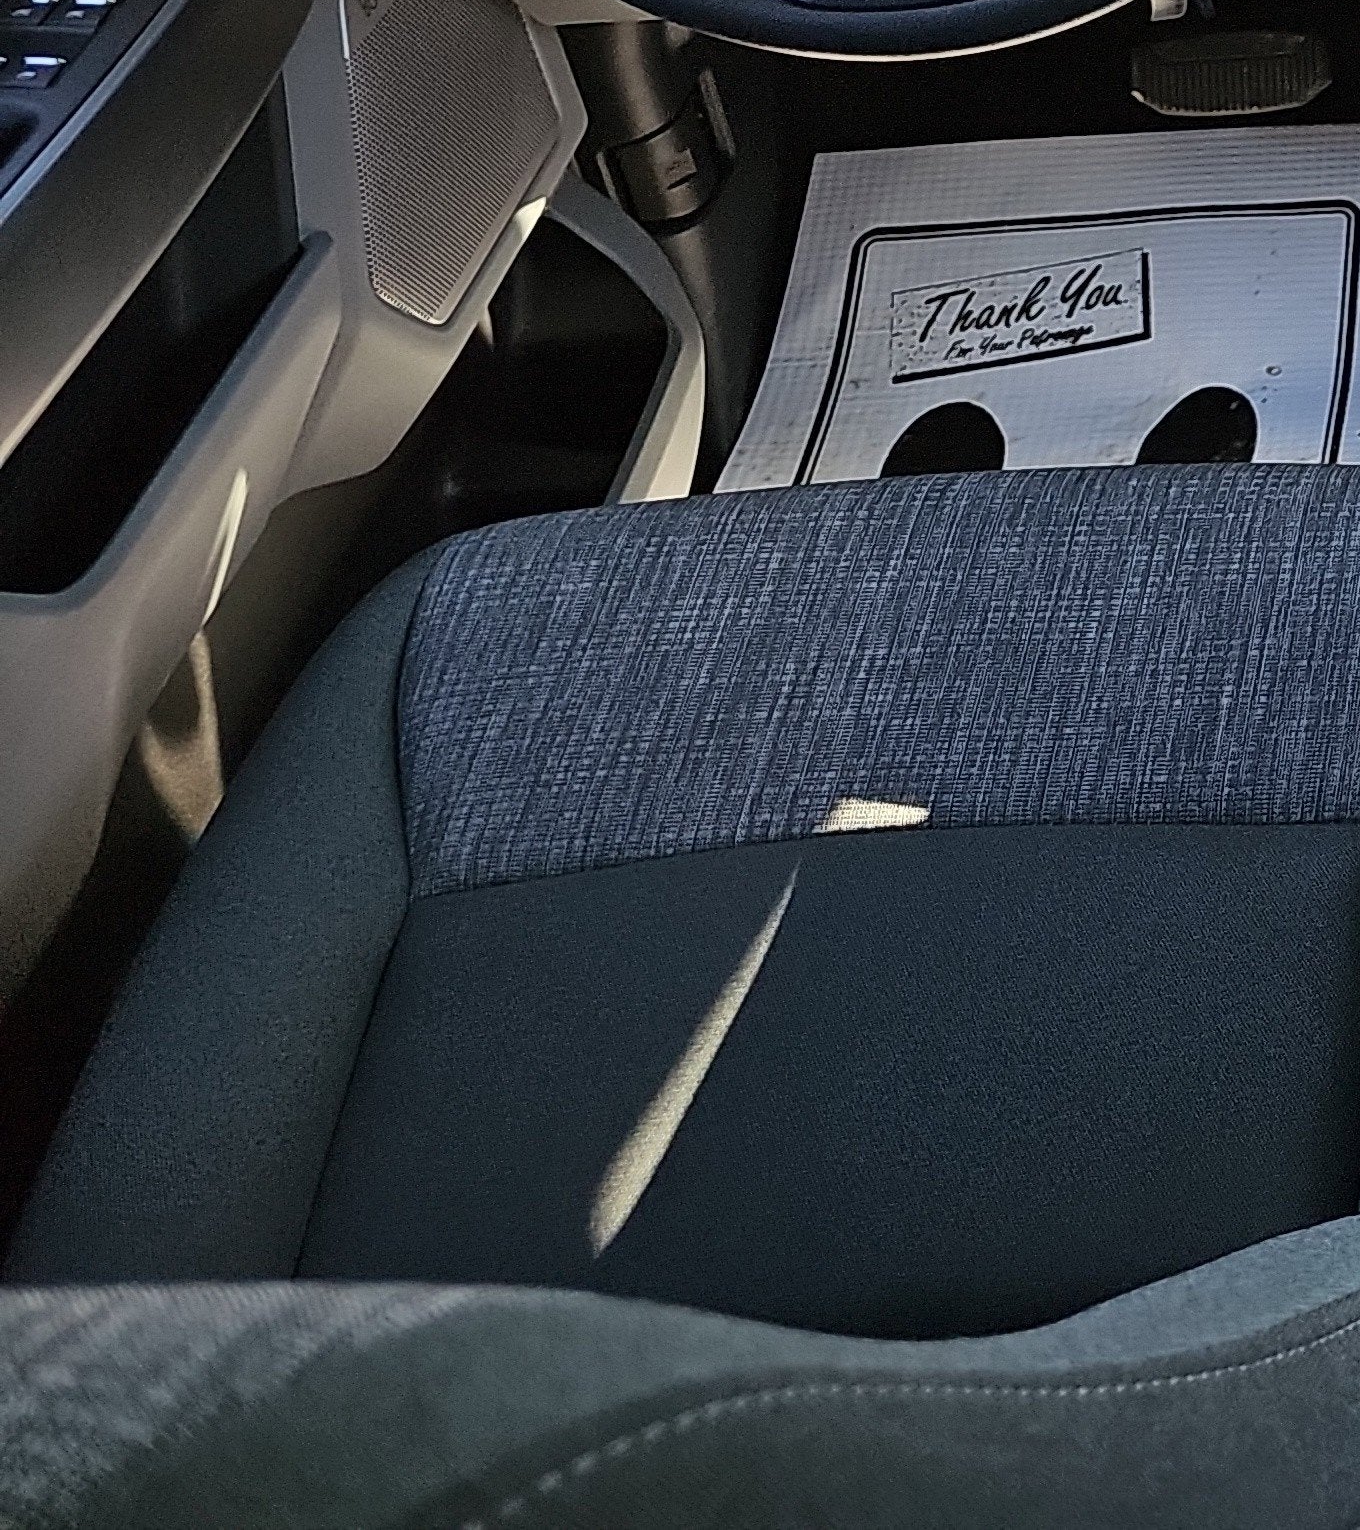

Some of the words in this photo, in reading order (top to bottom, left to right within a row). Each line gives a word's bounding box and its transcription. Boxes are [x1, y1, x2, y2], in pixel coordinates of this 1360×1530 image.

[919, 275, 1052, 342] Thank
[1060, 263, 1125, 318] You
[943, 338, 974, 360] For
